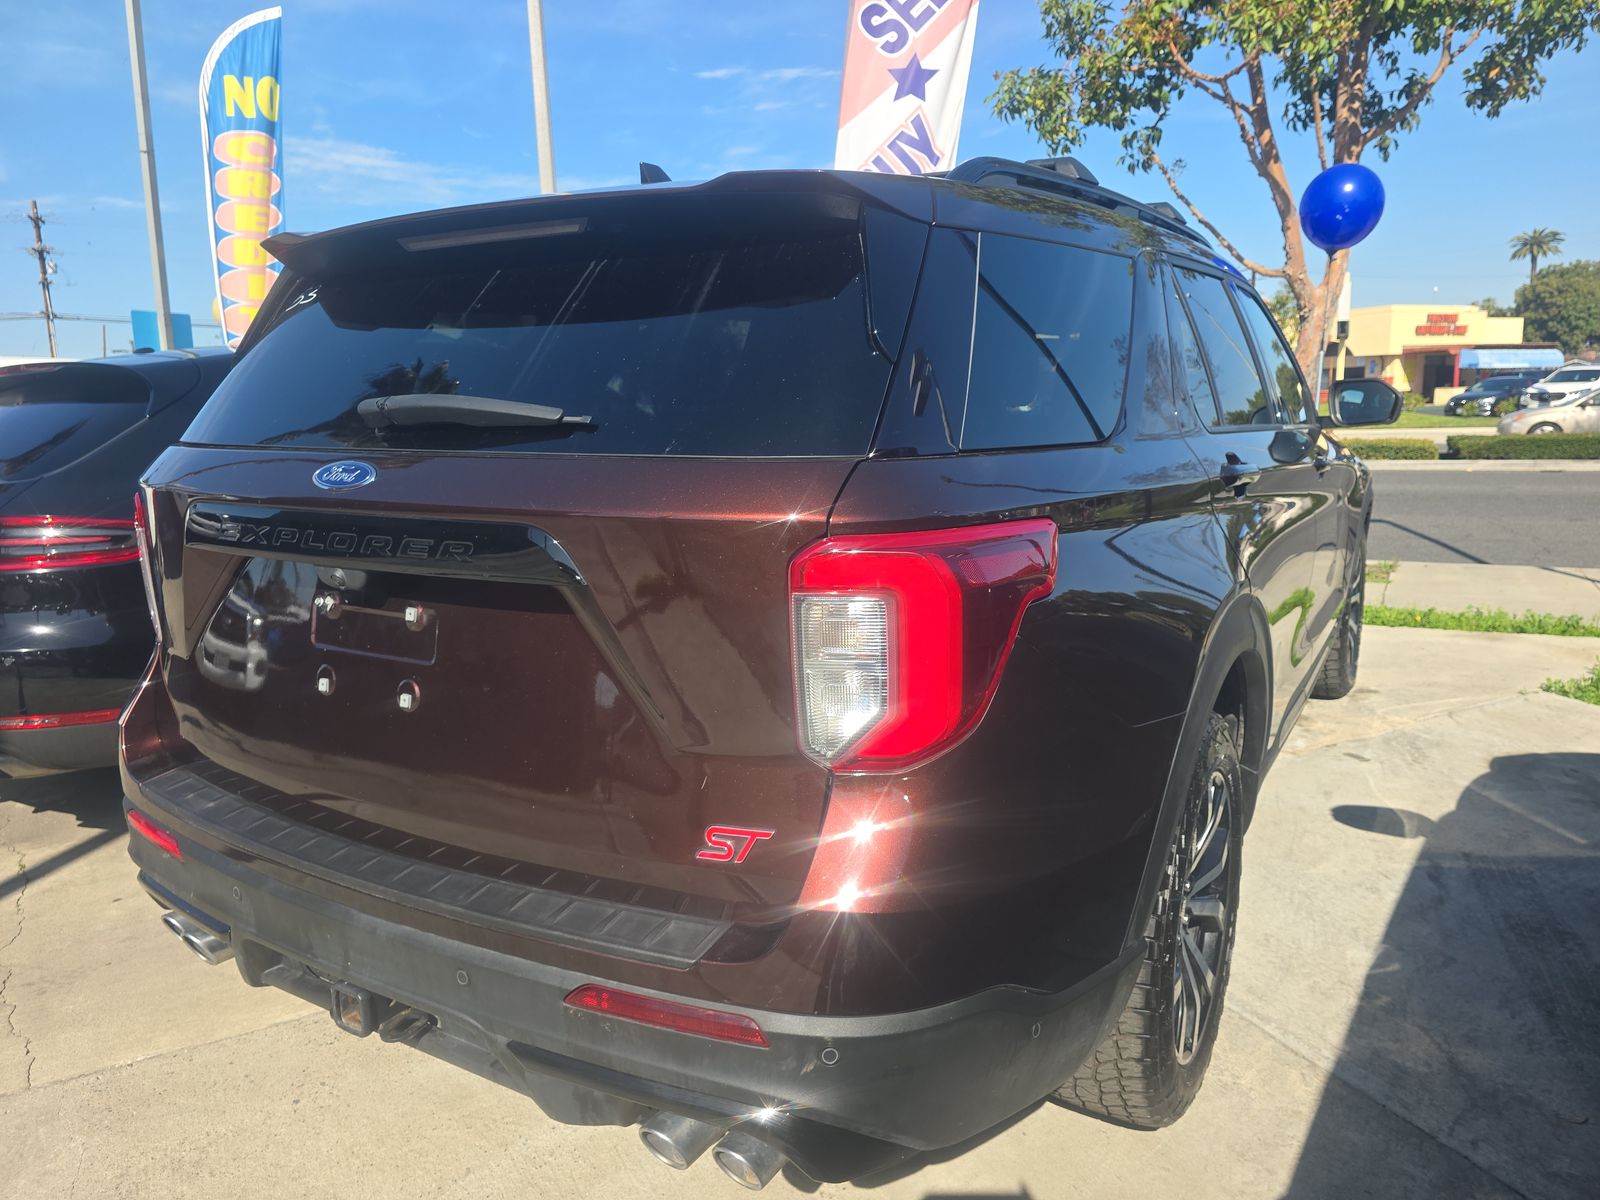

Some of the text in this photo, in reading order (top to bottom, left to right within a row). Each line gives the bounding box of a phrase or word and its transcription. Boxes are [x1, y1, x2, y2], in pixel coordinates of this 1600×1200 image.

[861, 0, 948, 54] SE
[223, 74, 280, 122] NO
[863, 113, 941, 176] UY
[322, 465, 361, 482] Ford
[218, 520, 474, 562] EXPLORER
[696, 825, 775, 863] ST
